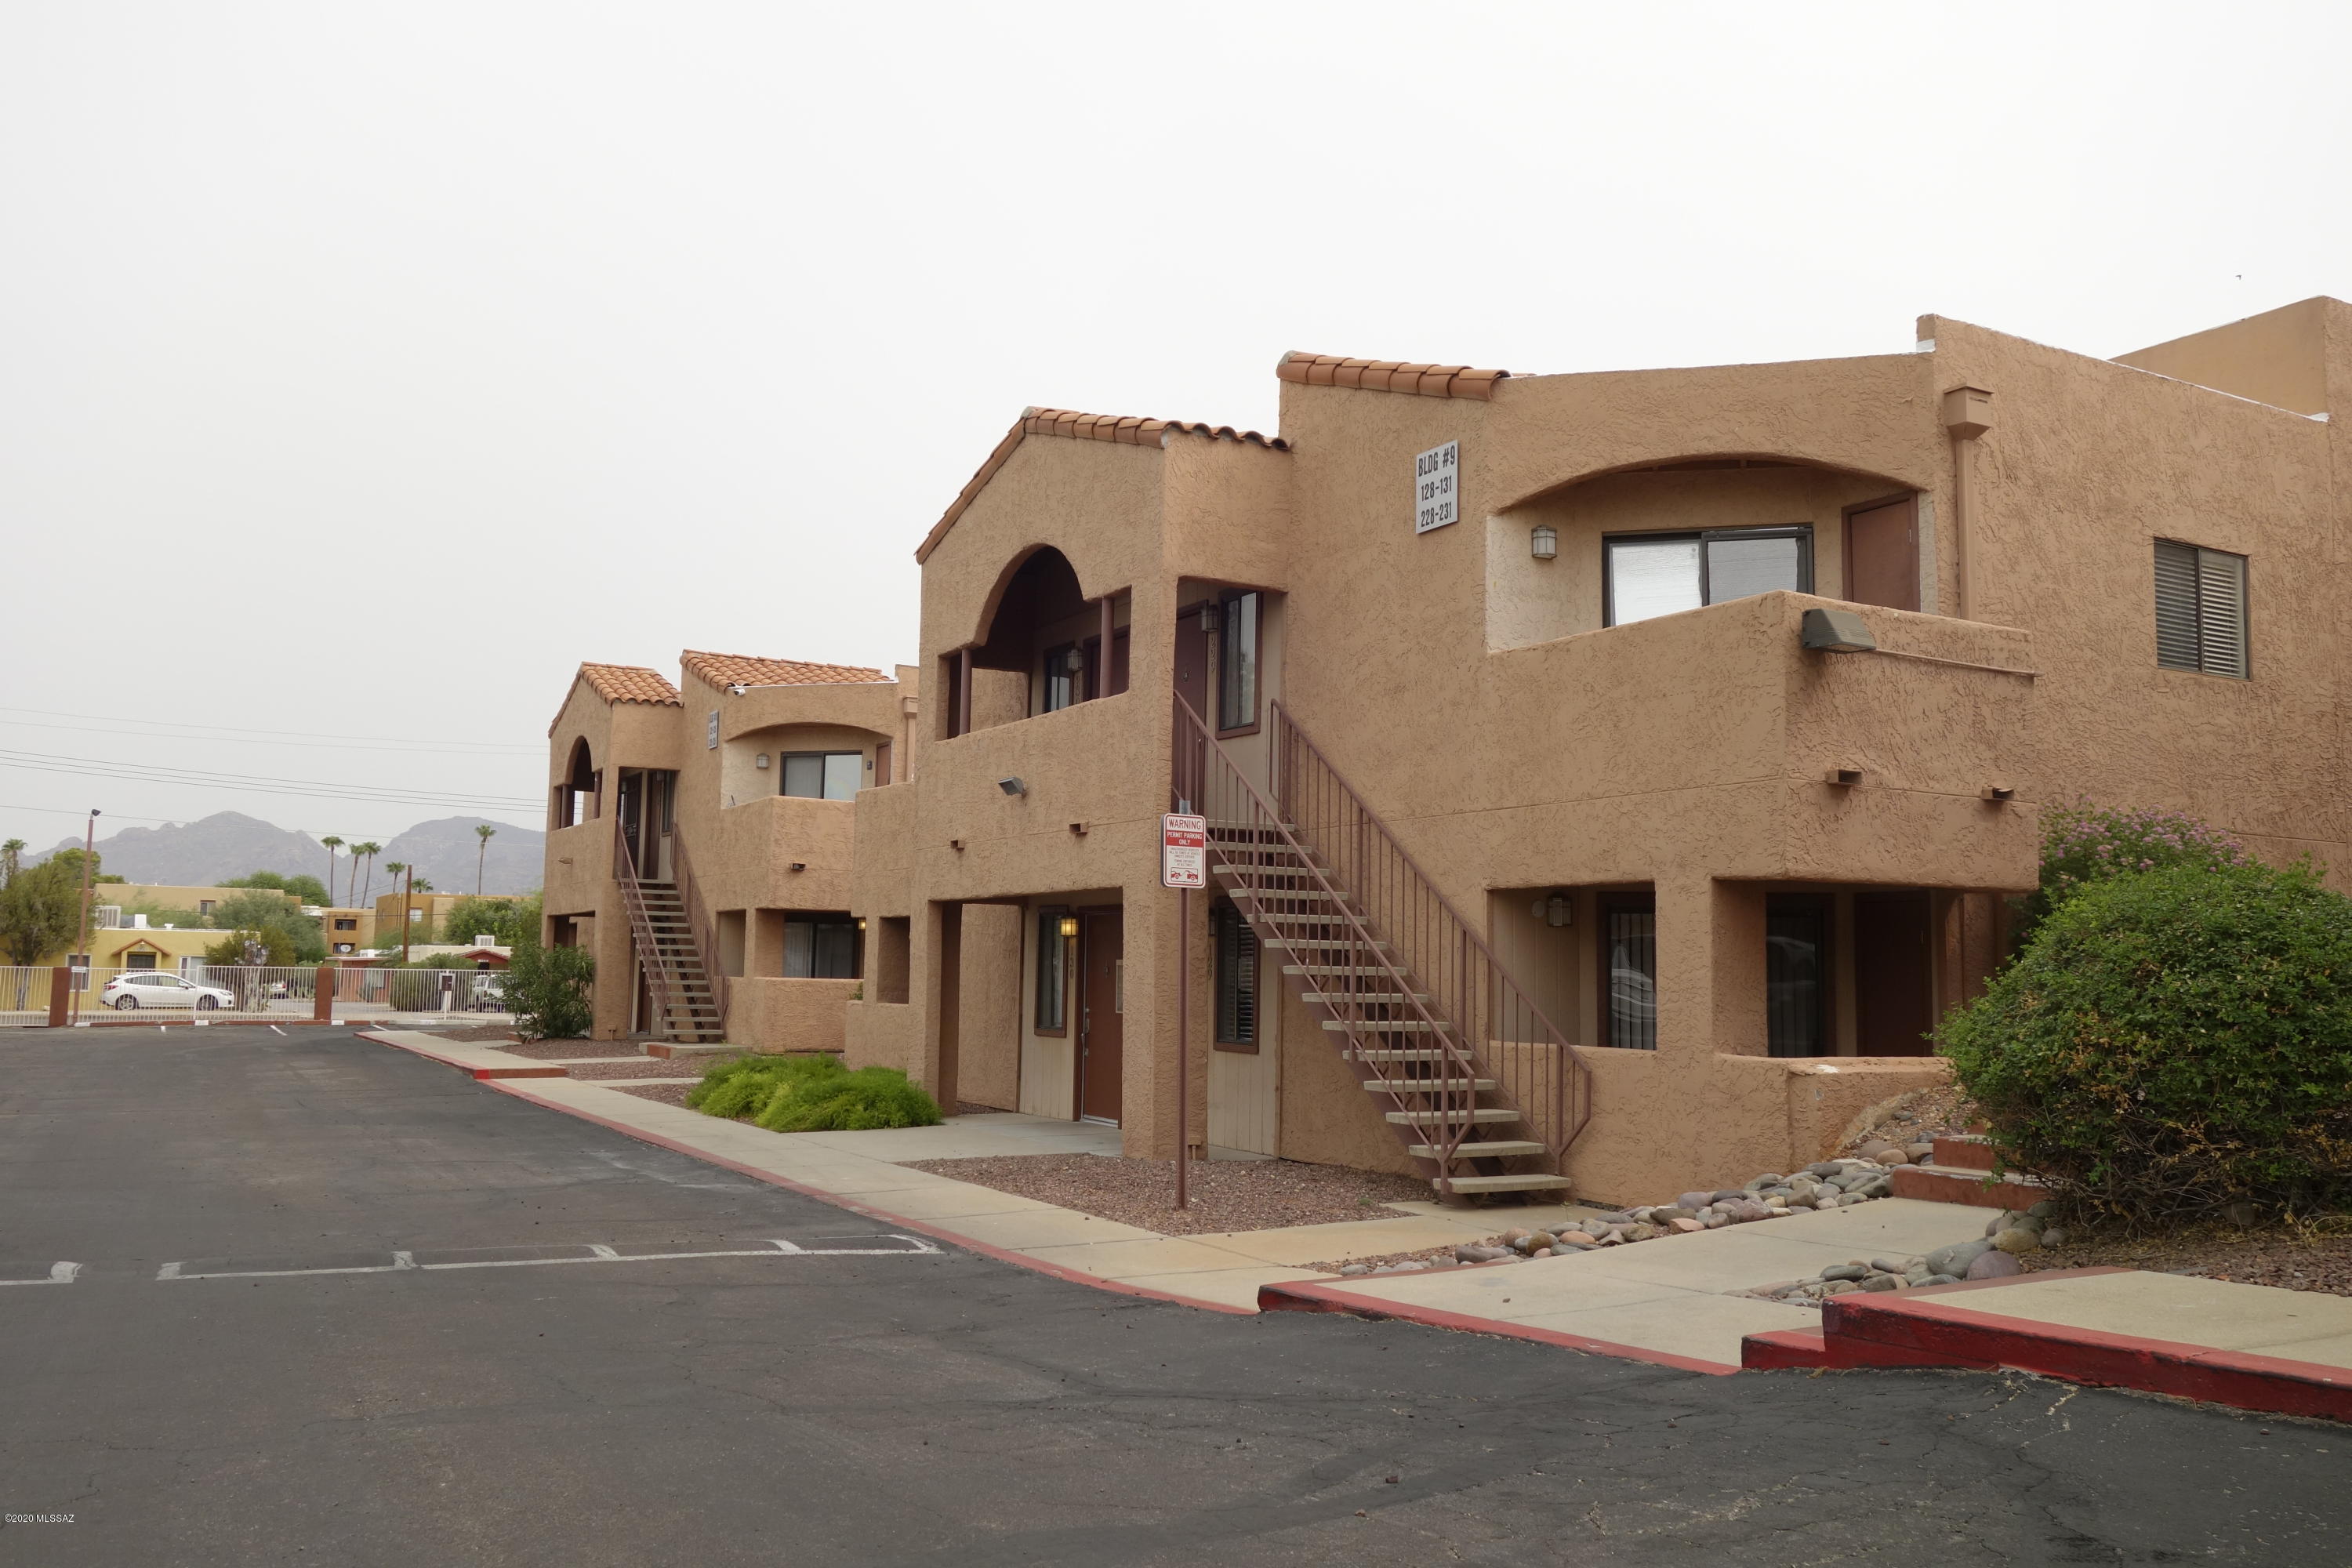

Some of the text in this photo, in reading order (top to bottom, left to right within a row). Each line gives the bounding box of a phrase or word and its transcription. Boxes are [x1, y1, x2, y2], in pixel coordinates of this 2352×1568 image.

[1417, 445, 1456, 477] BLDG #9
[1421, 474, 1452, 503] 128-131
[1421, 501, 1452, 528] 228-231
[1168, 818, 1201, 830] WARNING
